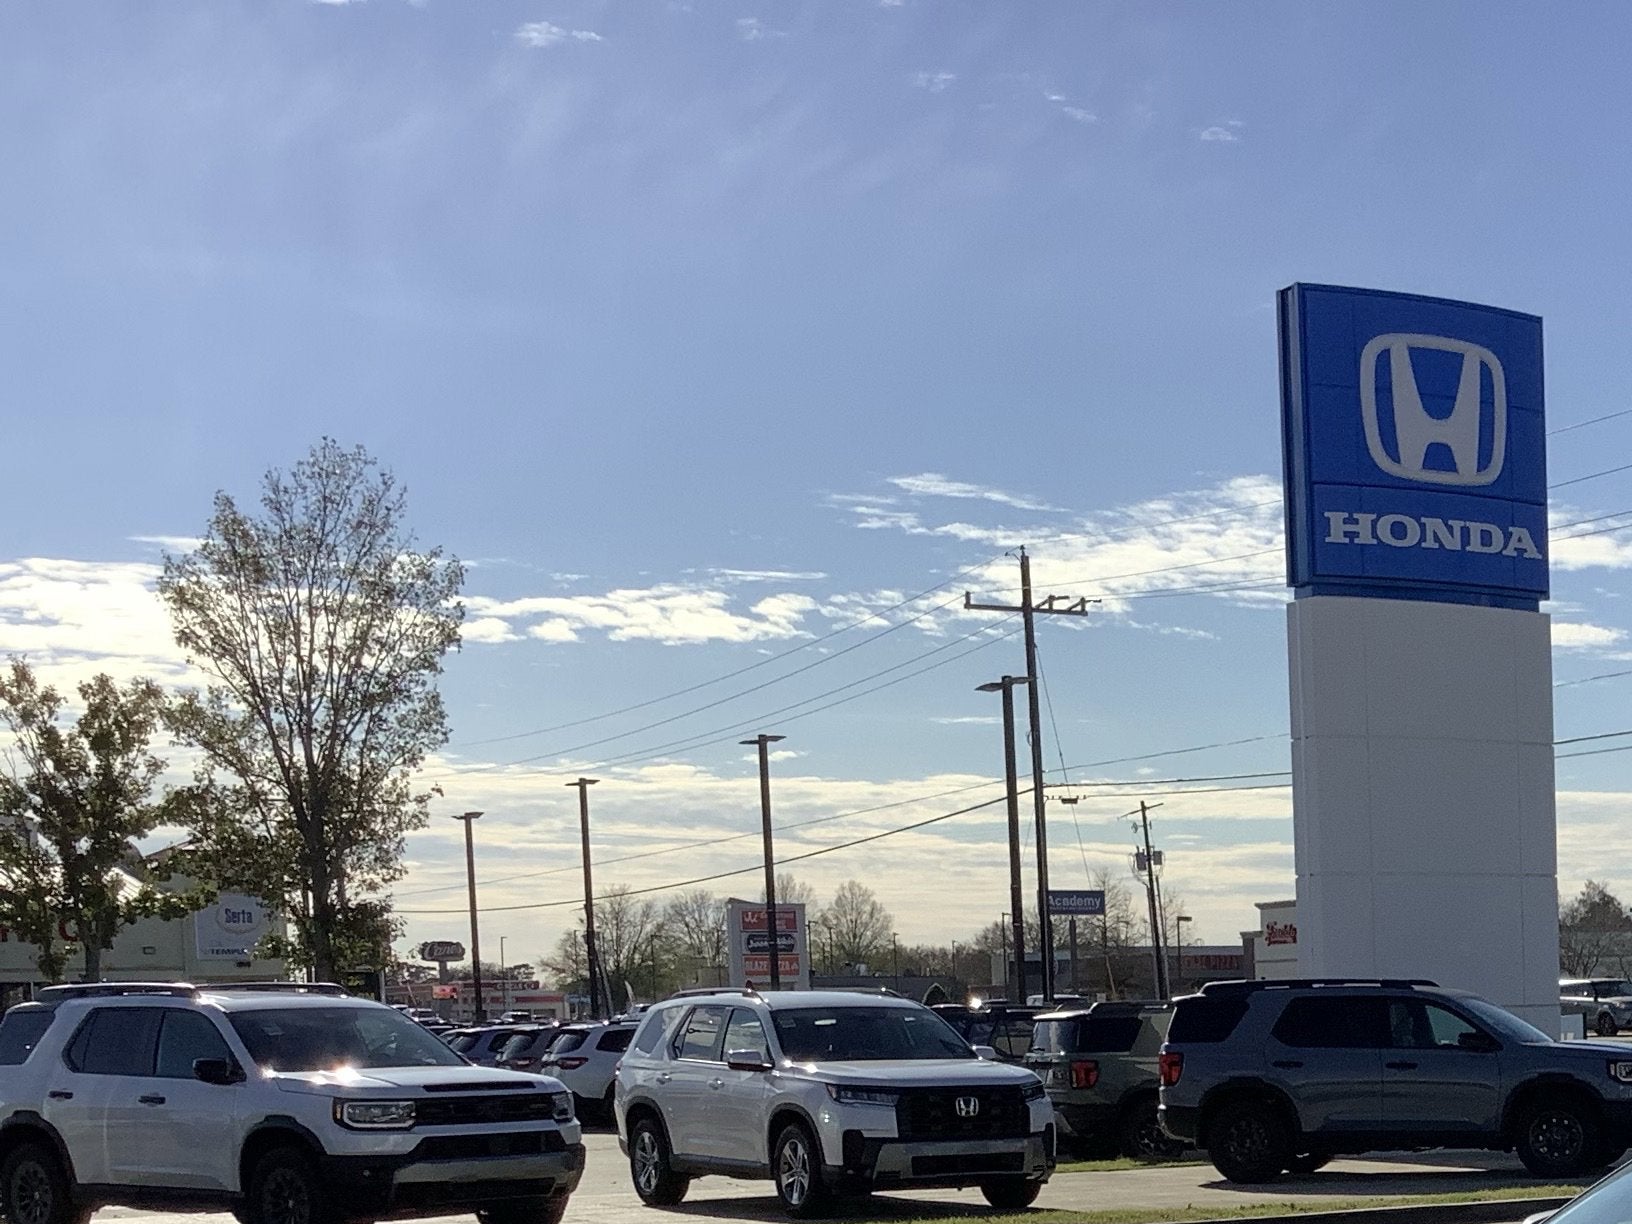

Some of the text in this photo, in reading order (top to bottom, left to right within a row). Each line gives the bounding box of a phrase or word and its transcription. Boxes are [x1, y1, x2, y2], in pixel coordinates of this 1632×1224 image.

[1324, 511, 1543, 560] HONDA
[1048, 894, 1101, 909] Academy
[224, 908, 253, 925] Serta
